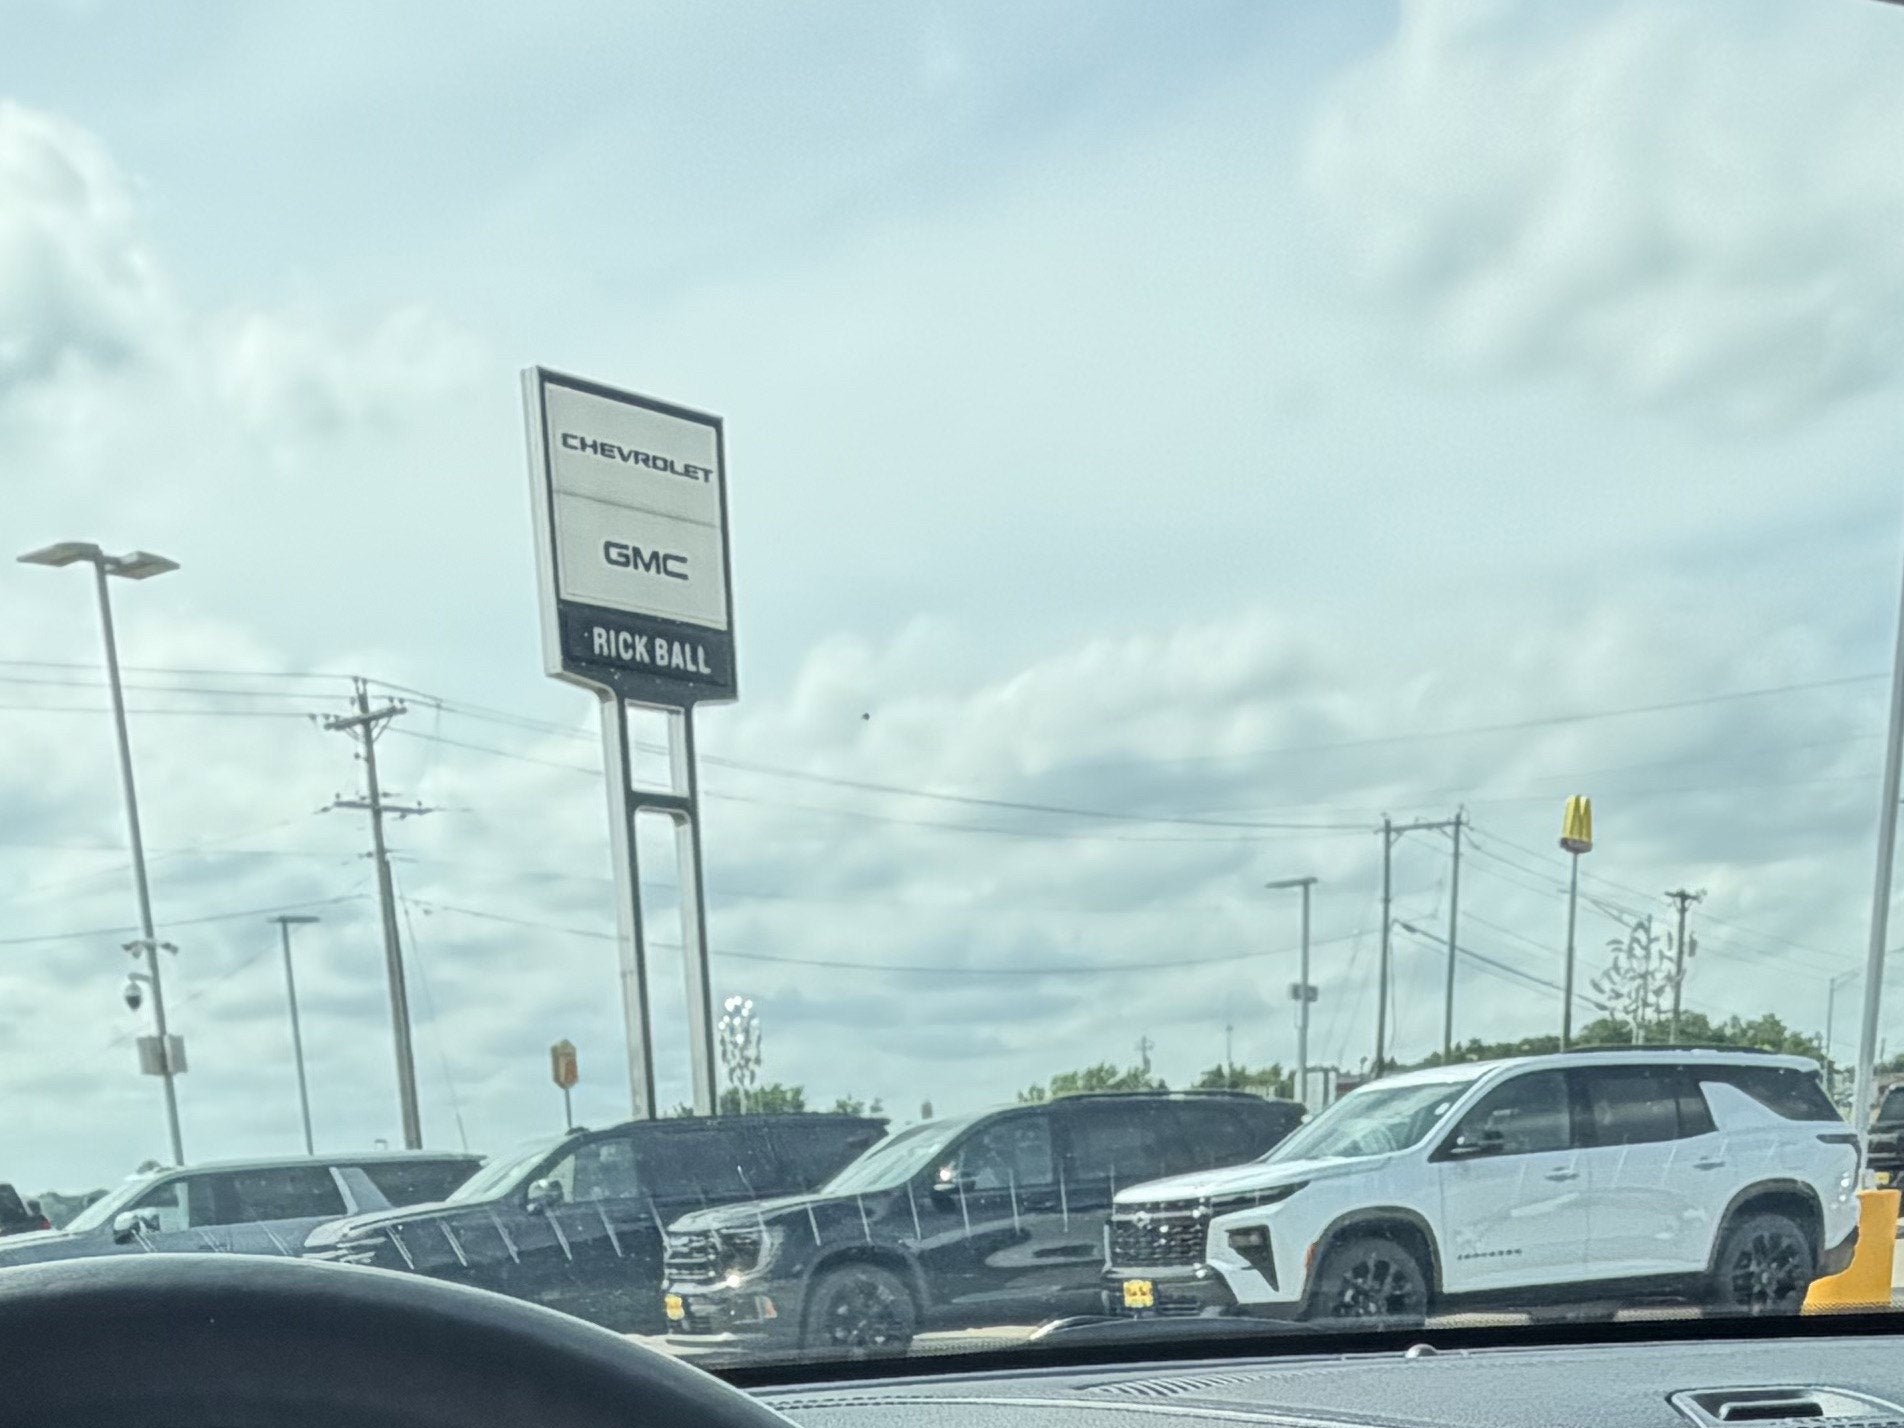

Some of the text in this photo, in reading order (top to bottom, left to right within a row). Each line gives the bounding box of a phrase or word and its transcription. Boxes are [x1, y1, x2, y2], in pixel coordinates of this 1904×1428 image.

[561, 432, 714, 483] CHEVROLET
[603, 540, 689, 581] GMC
[592, 626, 712, 674] RICK BALL
